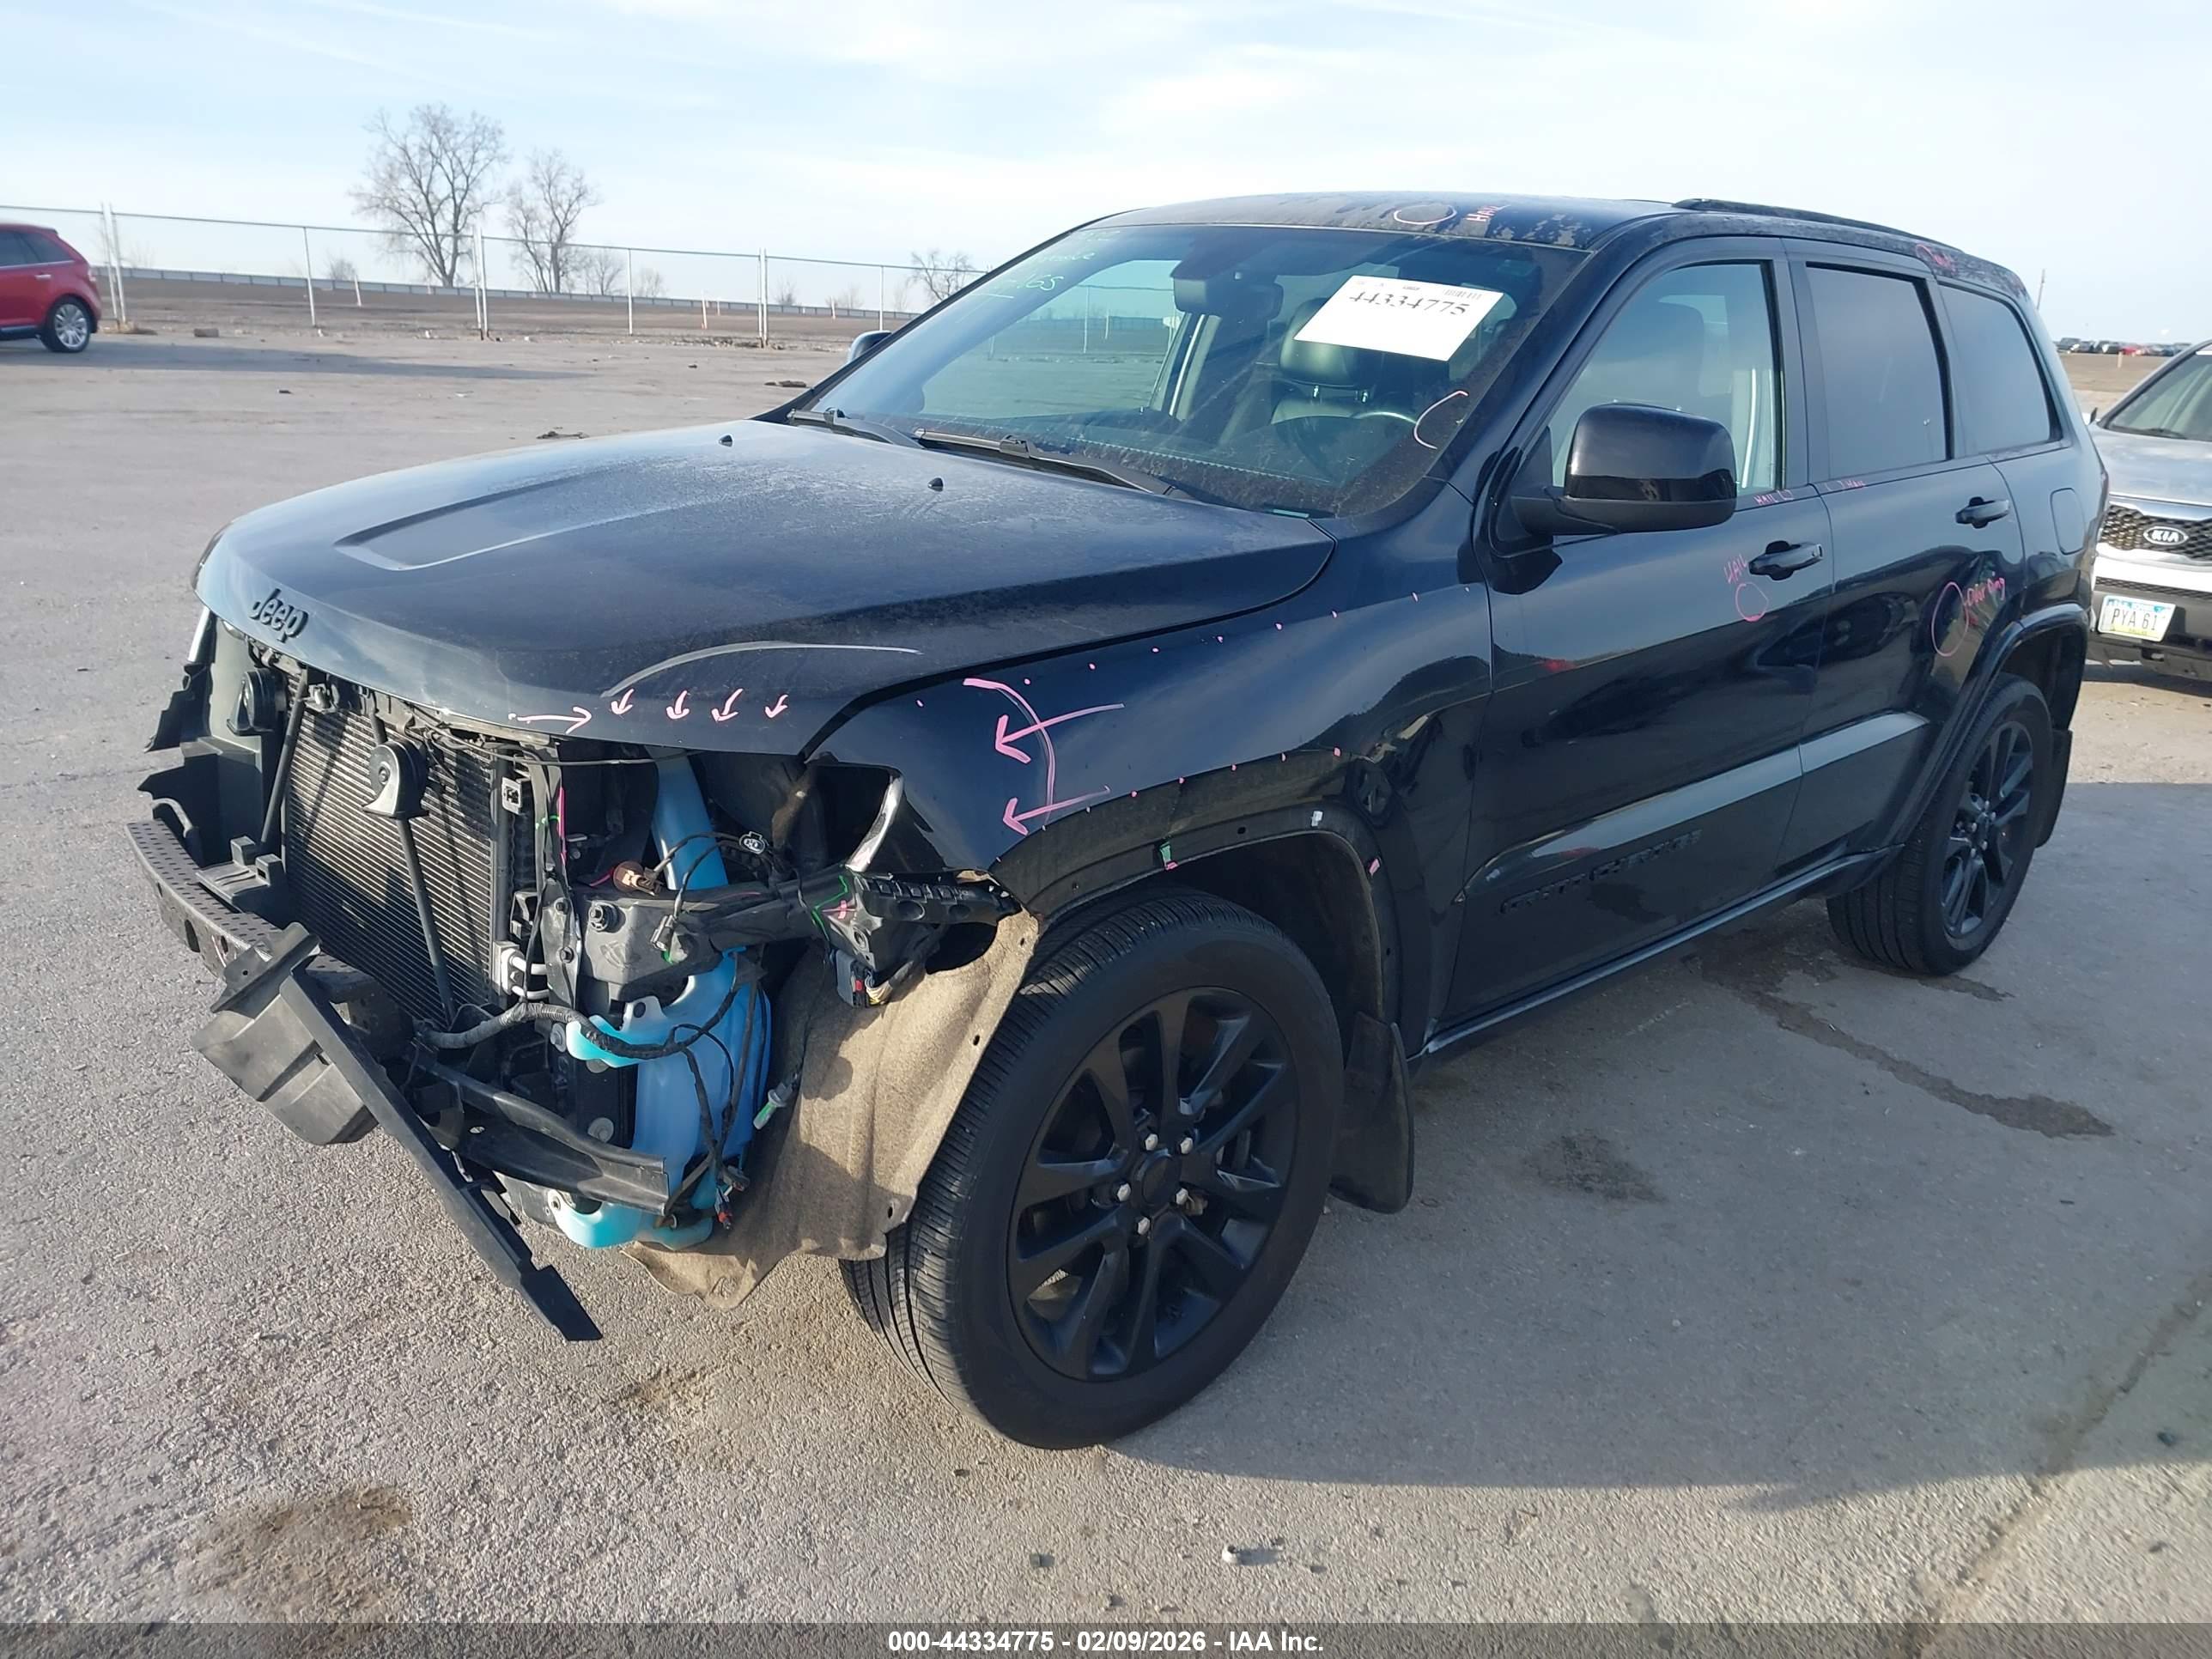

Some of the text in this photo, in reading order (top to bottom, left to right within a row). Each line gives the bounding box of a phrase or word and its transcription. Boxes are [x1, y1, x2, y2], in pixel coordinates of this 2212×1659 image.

[1349, 291, 1470, 315] 44334775
[2150, 529, 2180, 543] KIA
[2111, 608, 2138, 628] PYA
